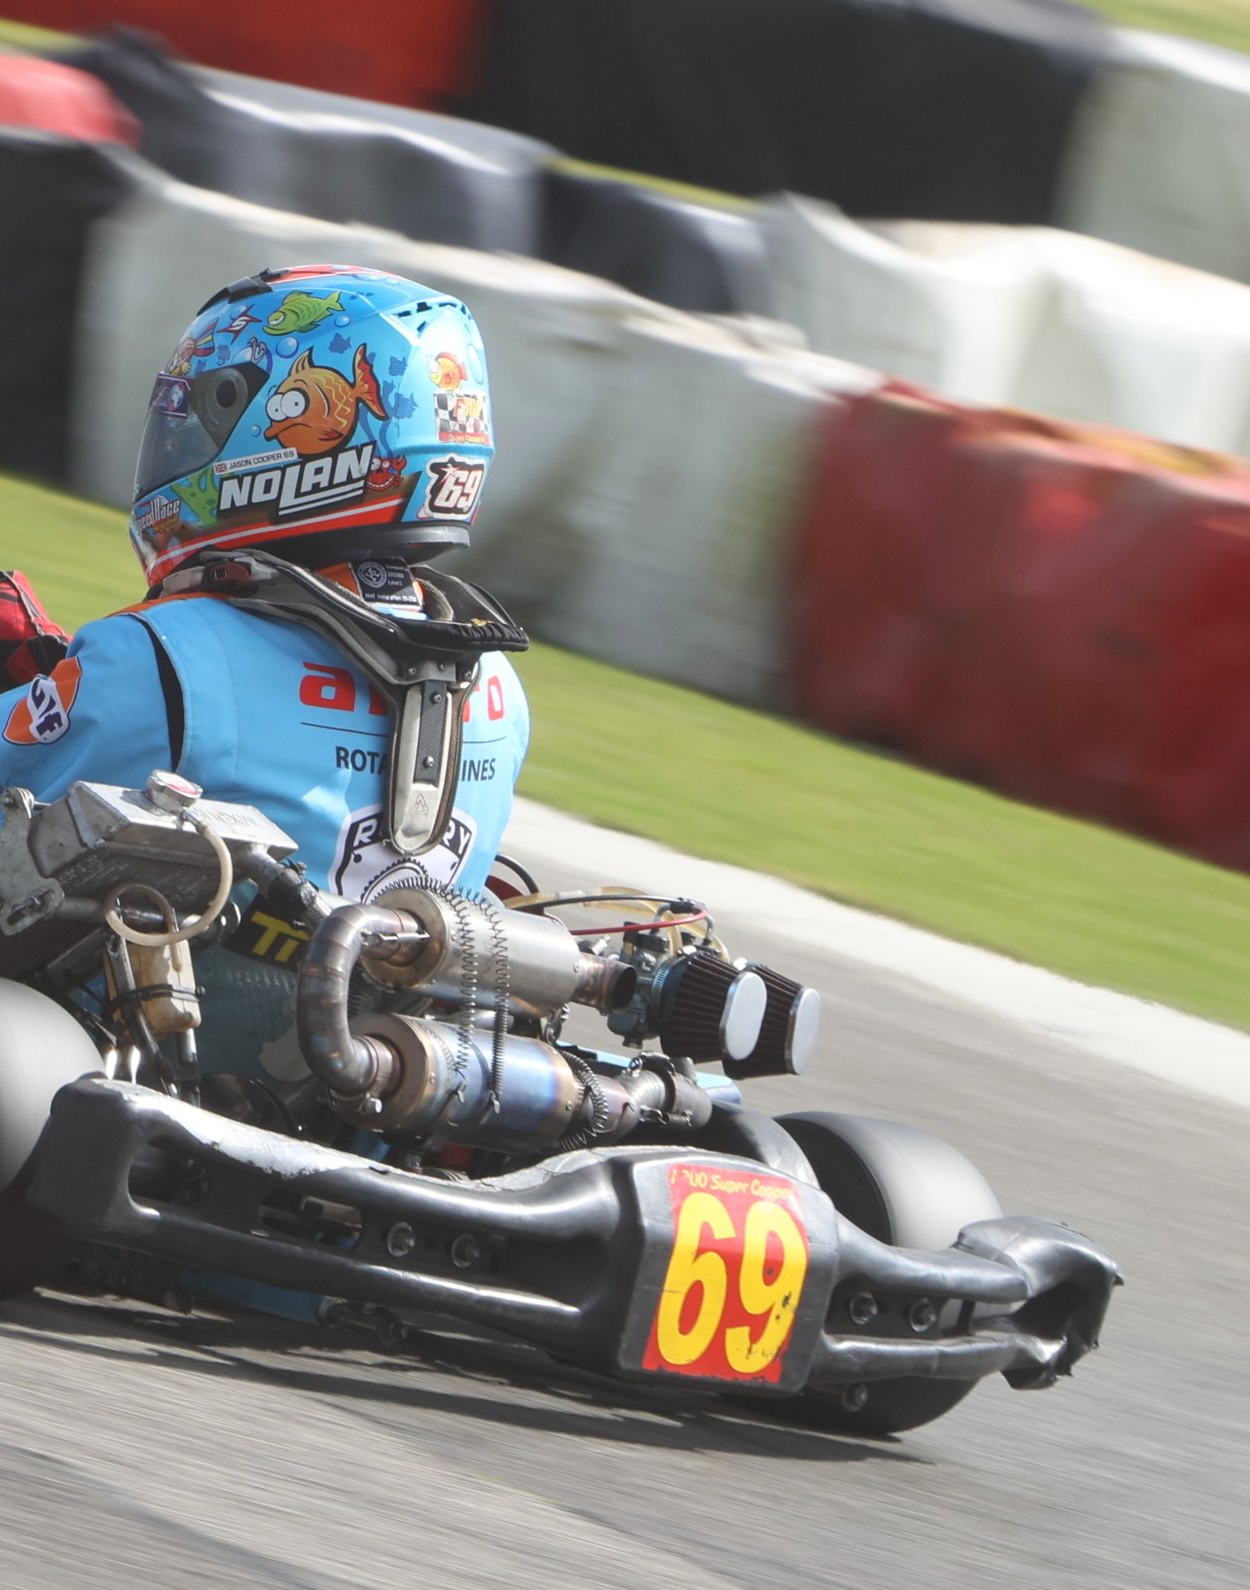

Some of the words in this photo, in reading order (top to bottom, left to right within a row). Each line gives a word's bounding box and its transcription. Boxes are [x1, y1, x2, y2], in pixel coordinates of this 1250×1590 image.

[219, 445, 374, 511] NOLAN
[228, 459, 252, 470] JASON
[252, 453, 283, 465] COOPER
[283, 450, 295, 459] 69
[434, 469, 484, 509] 69
[709, 1174, 749, 1194] Super
[749, 1178, 794, 1200] Cooper
[657, 1191, 808, 1374] 69
